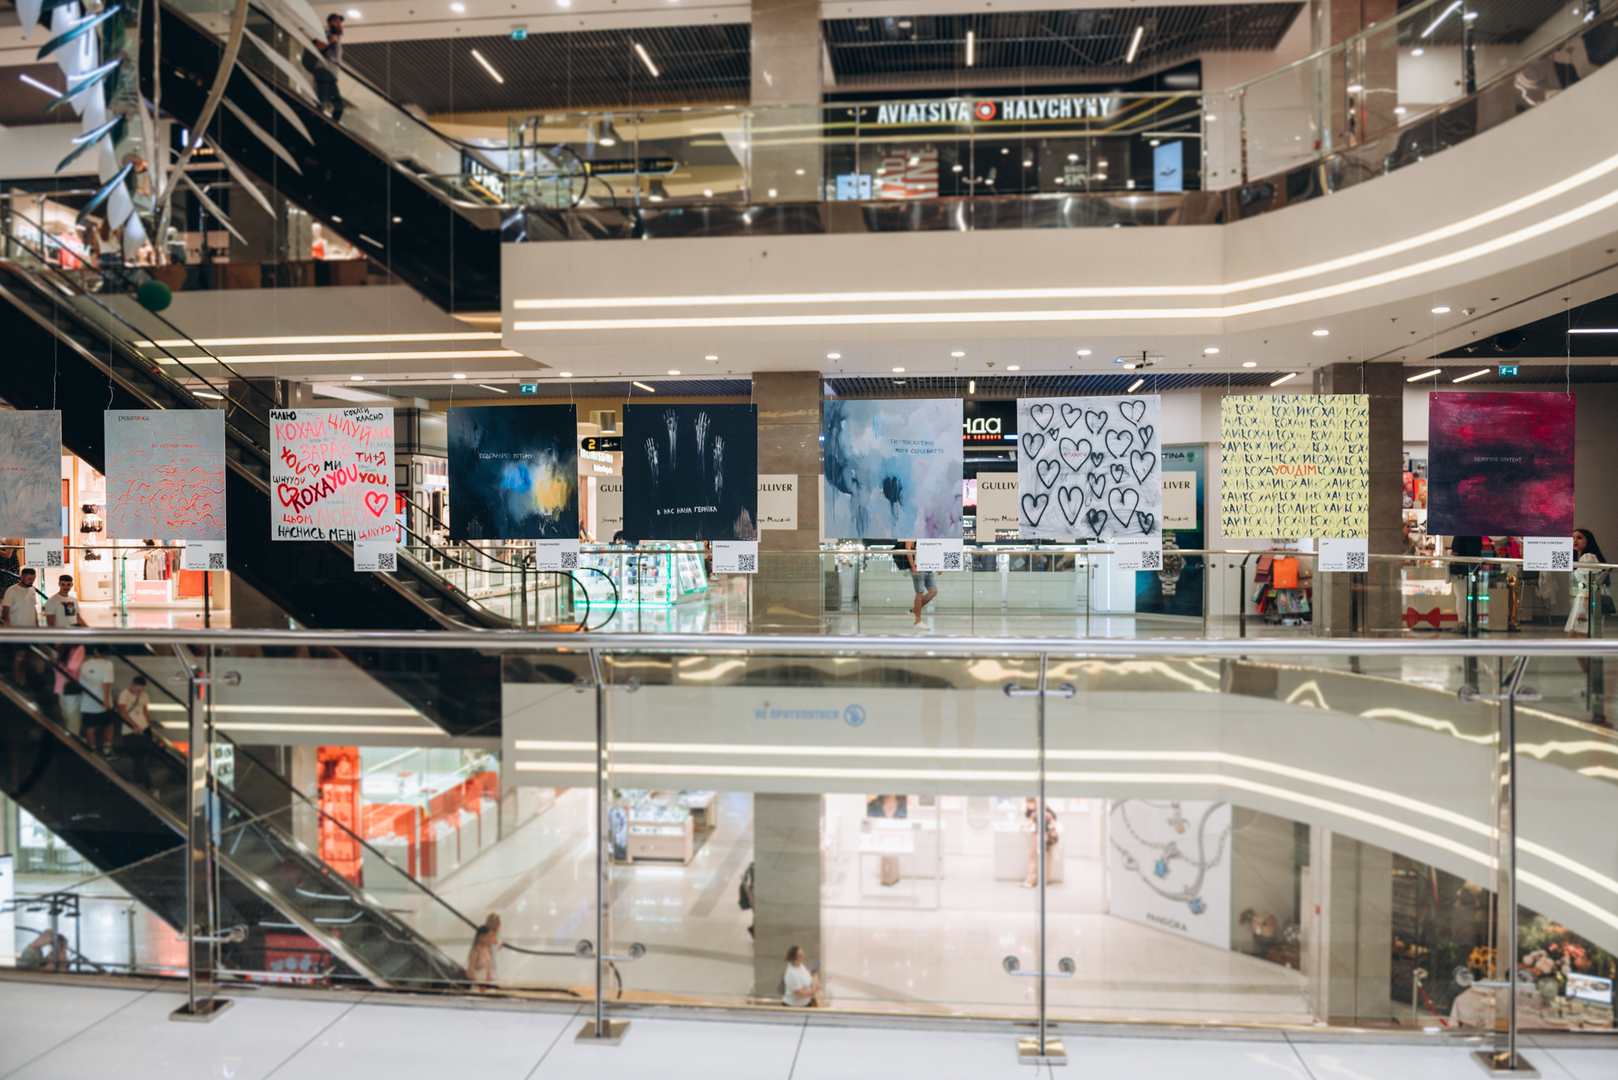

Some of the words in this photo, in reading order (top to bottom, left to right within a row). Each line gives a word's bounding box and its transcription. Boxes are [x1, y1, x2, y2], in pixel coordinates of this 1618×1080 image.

[877, 102, 970, 124] AVIATSIYA
[1002, 98, 1111, 120] HALYCHYNY
[275, 416, 327, 441] КОХАЙ
[328, 412, 372, 446] ЦІЛУЙ
[300, 438, 352, 463] ЗАРАЗ
[588, 439, 596, 450] 2
[324, 460, 342, 471] МИ
[982, 482, 1018, 490] GULLIV
[1162, 481, 1191, 490] LIVER
[283, 514, 313, 525] ЦЬОМ
[278, 525, 326, 540] НАСНИСЬ
[329, 528, 356, 541] МЕНІ
